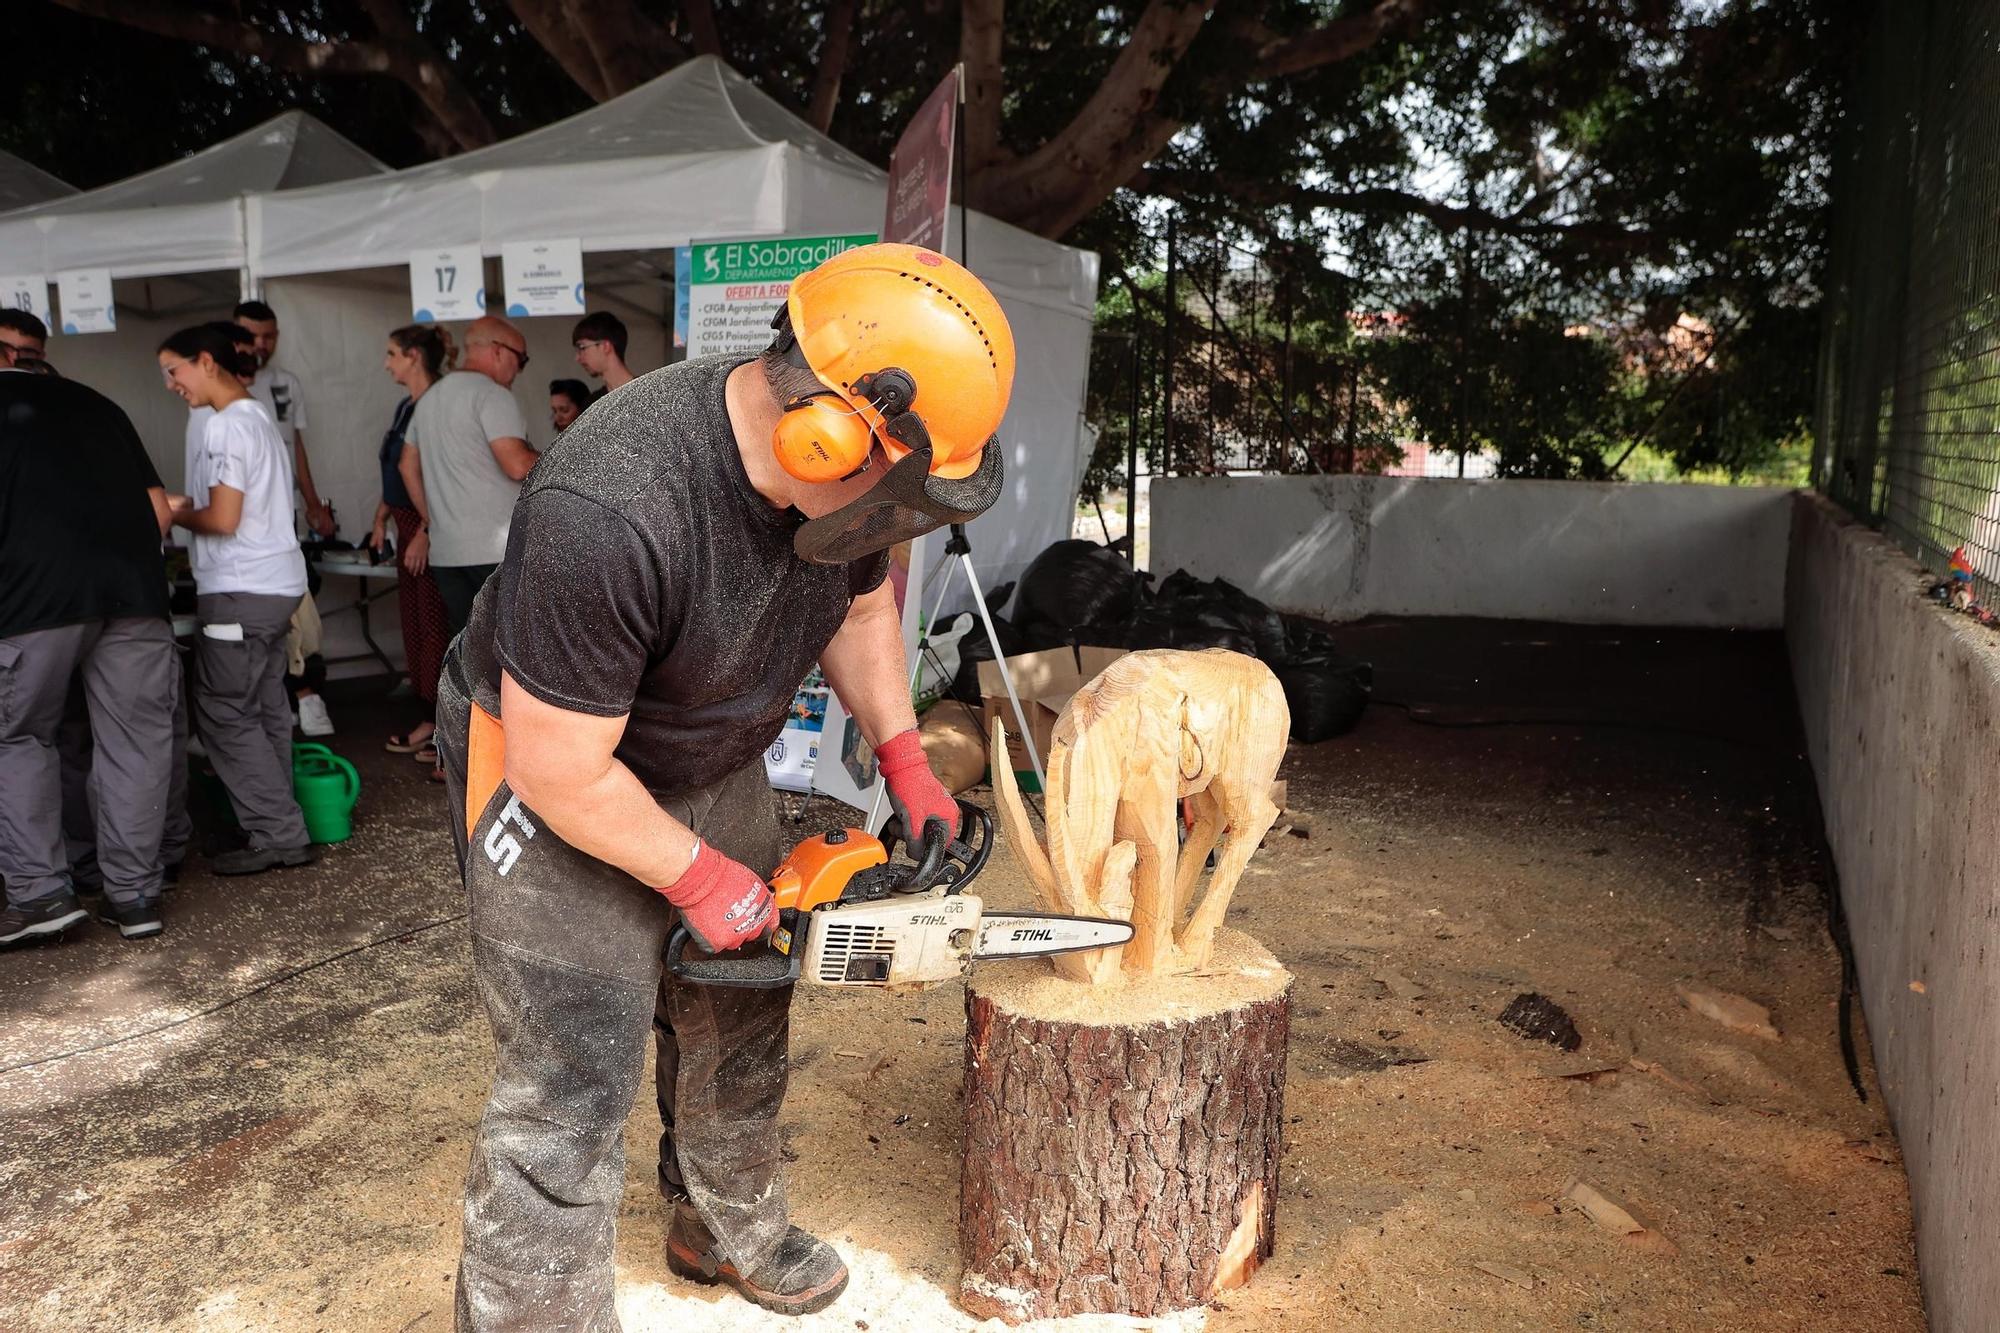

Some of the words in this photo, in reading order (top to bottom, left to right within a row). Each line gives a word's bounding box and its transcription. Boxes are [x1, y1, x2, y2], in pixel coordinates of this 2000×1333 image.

[725, 244, 742, 268] El
[434, 265, 457, 293] 17
[724, 266, 798, 280] DEPARTAMENTO
[725, 286, 766, 299] OFERTA
[14, 291, 32, 314] 18
[703, 303, 726, 314] CFGB
[702, 317, 727, 327] CFGM
[701, 331, 724, 341] CFGS
[700, 345, 720, 354] DUAL
[810, 441, 830, 462] STIHL
[909, 915, 948, 926] STIHL
[1010, 929, 1054, 942] STIHL
